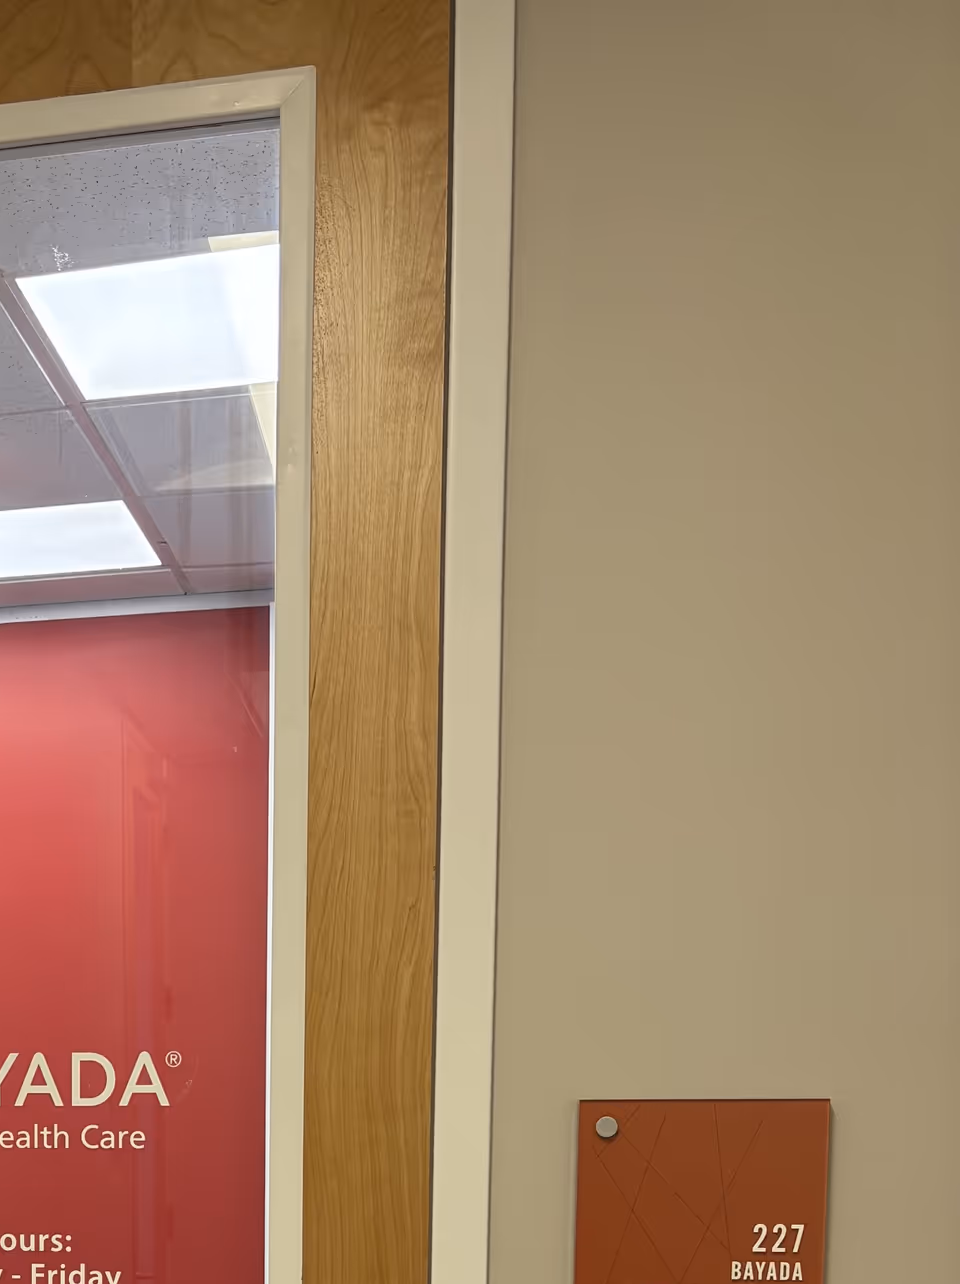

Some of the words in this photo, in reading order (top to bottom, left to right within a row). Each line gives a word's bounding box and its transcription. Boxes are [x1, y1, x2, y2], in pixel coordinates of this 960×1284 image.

[81, 1125, 146, 1149] Care
[752, 1223, 805, 1253] 227
[731, 1261, 803, 1281] BAYADA
